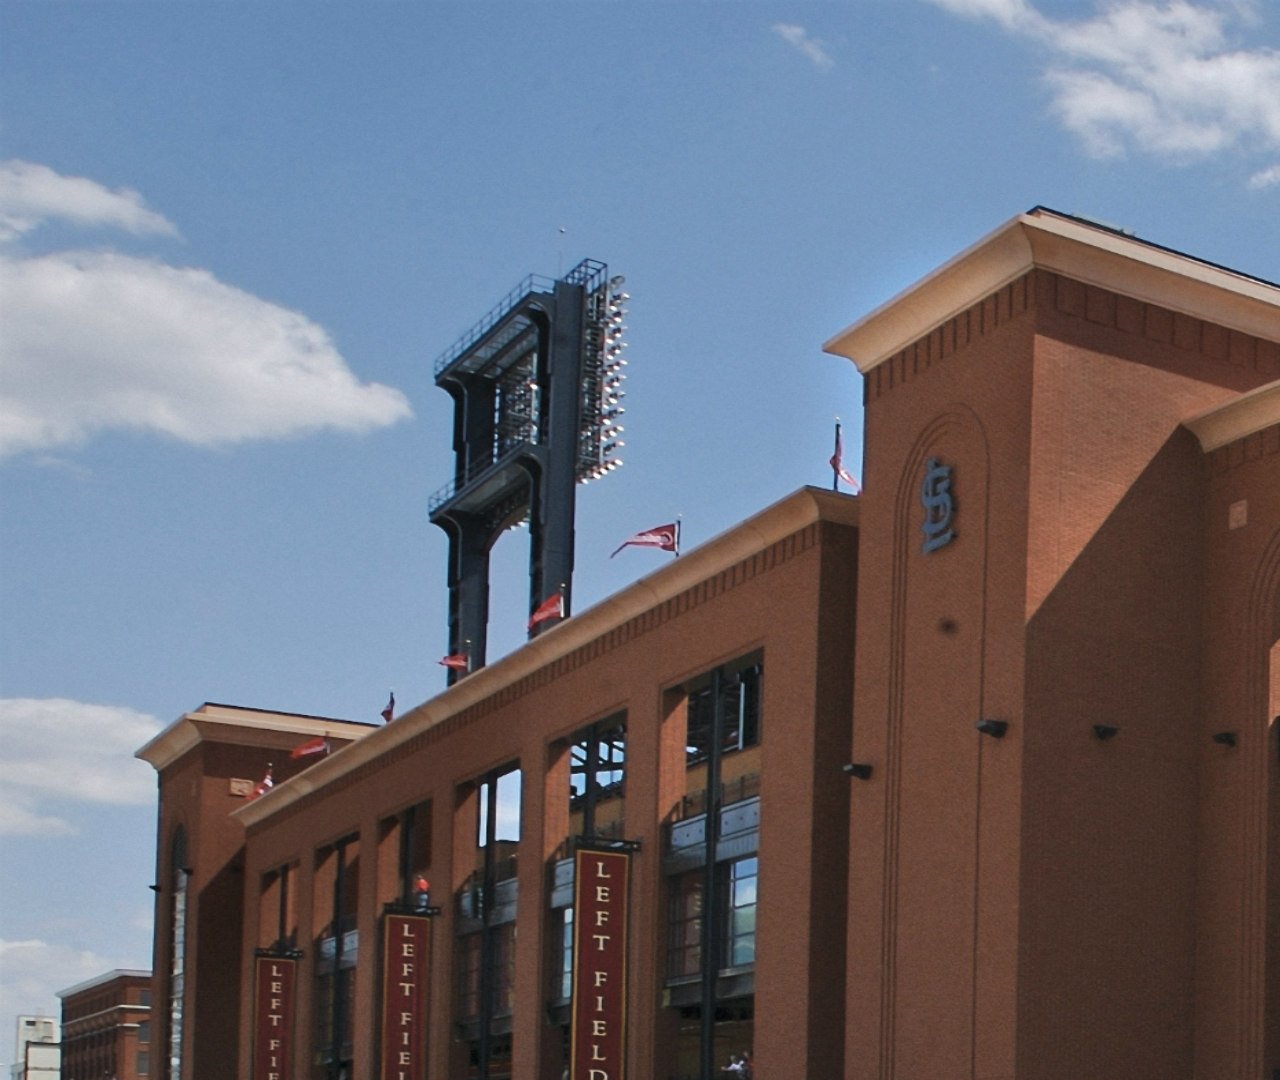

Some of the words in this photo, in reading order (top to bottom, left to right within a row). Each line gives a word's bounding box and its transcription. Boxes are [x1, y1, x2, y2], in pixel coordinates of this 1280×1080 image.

[592, 862, 611, 952] LEFT
[268, 965, 283, 1027] LEFT
[399, 923, 415, 997] LEFT
